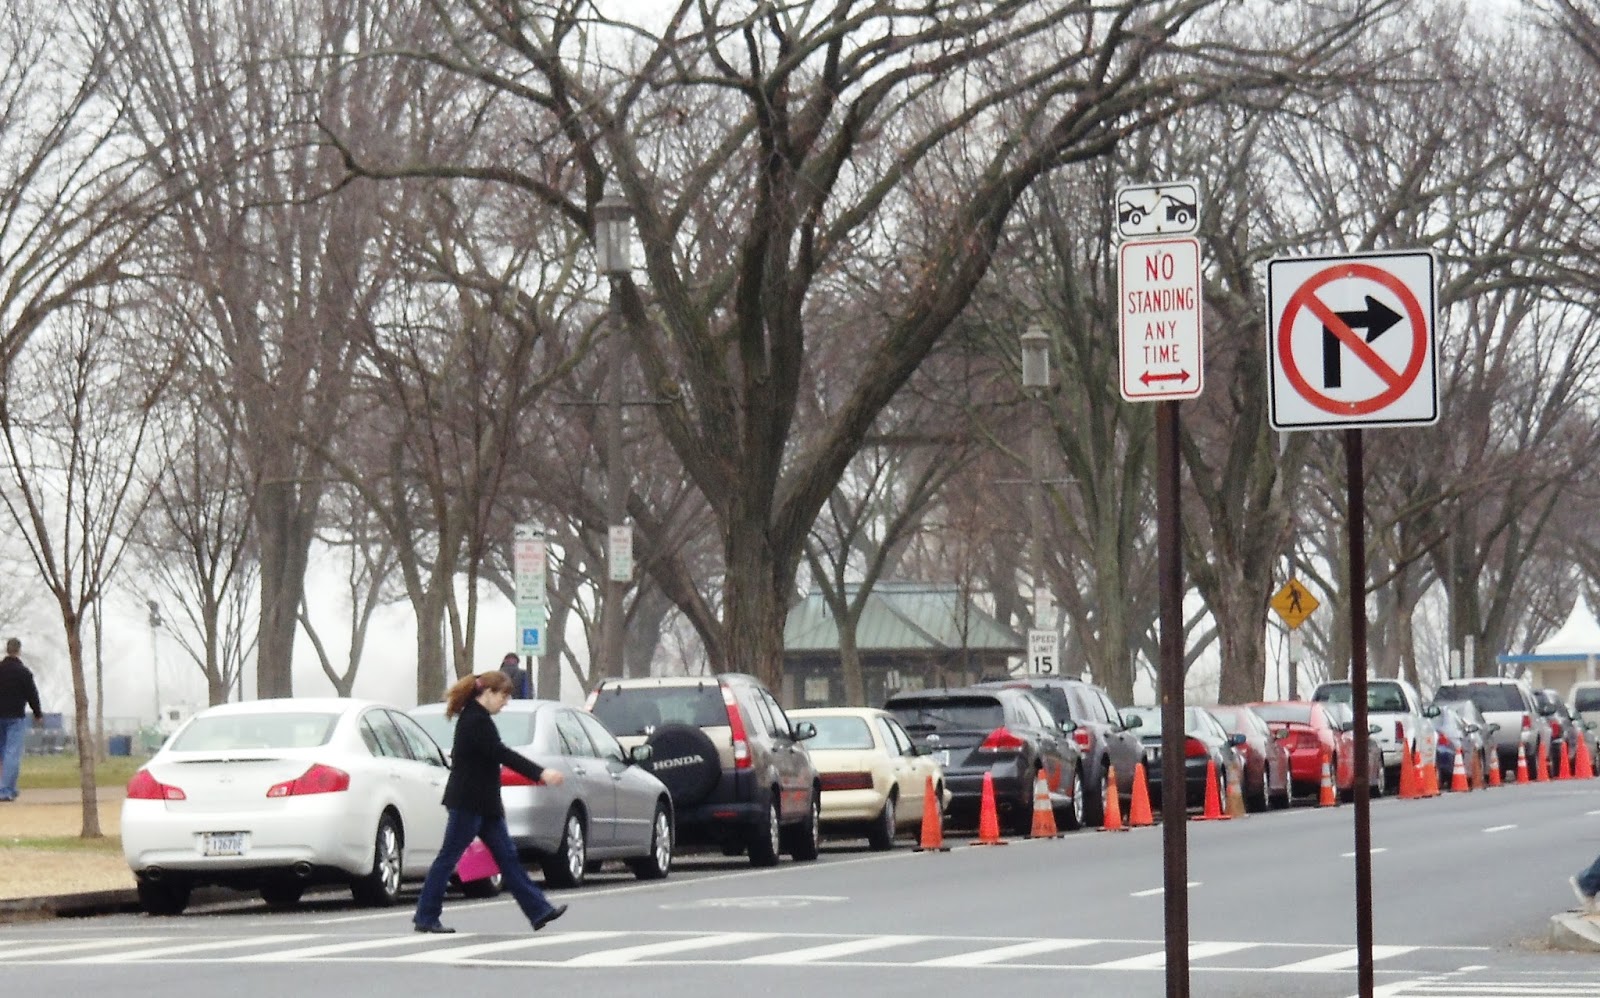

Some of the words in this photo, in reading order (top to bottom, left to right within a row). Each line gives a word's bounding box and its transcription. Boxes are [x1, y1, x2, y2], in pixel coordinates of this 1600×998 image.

[1146, 253, 1174, 281] NO
[1128, 287, 1194, 314] STANDING
[1145, 320, 1177, 340] ANY
[1142, 344, 1180, 364] TIME
[1031, 635, 1056, 643] SPEED
[1033, 645, 1053, 653] LIMIT
[1035, 656, 1053, 673] 15
[653, 755, 704, 770] HONDA
